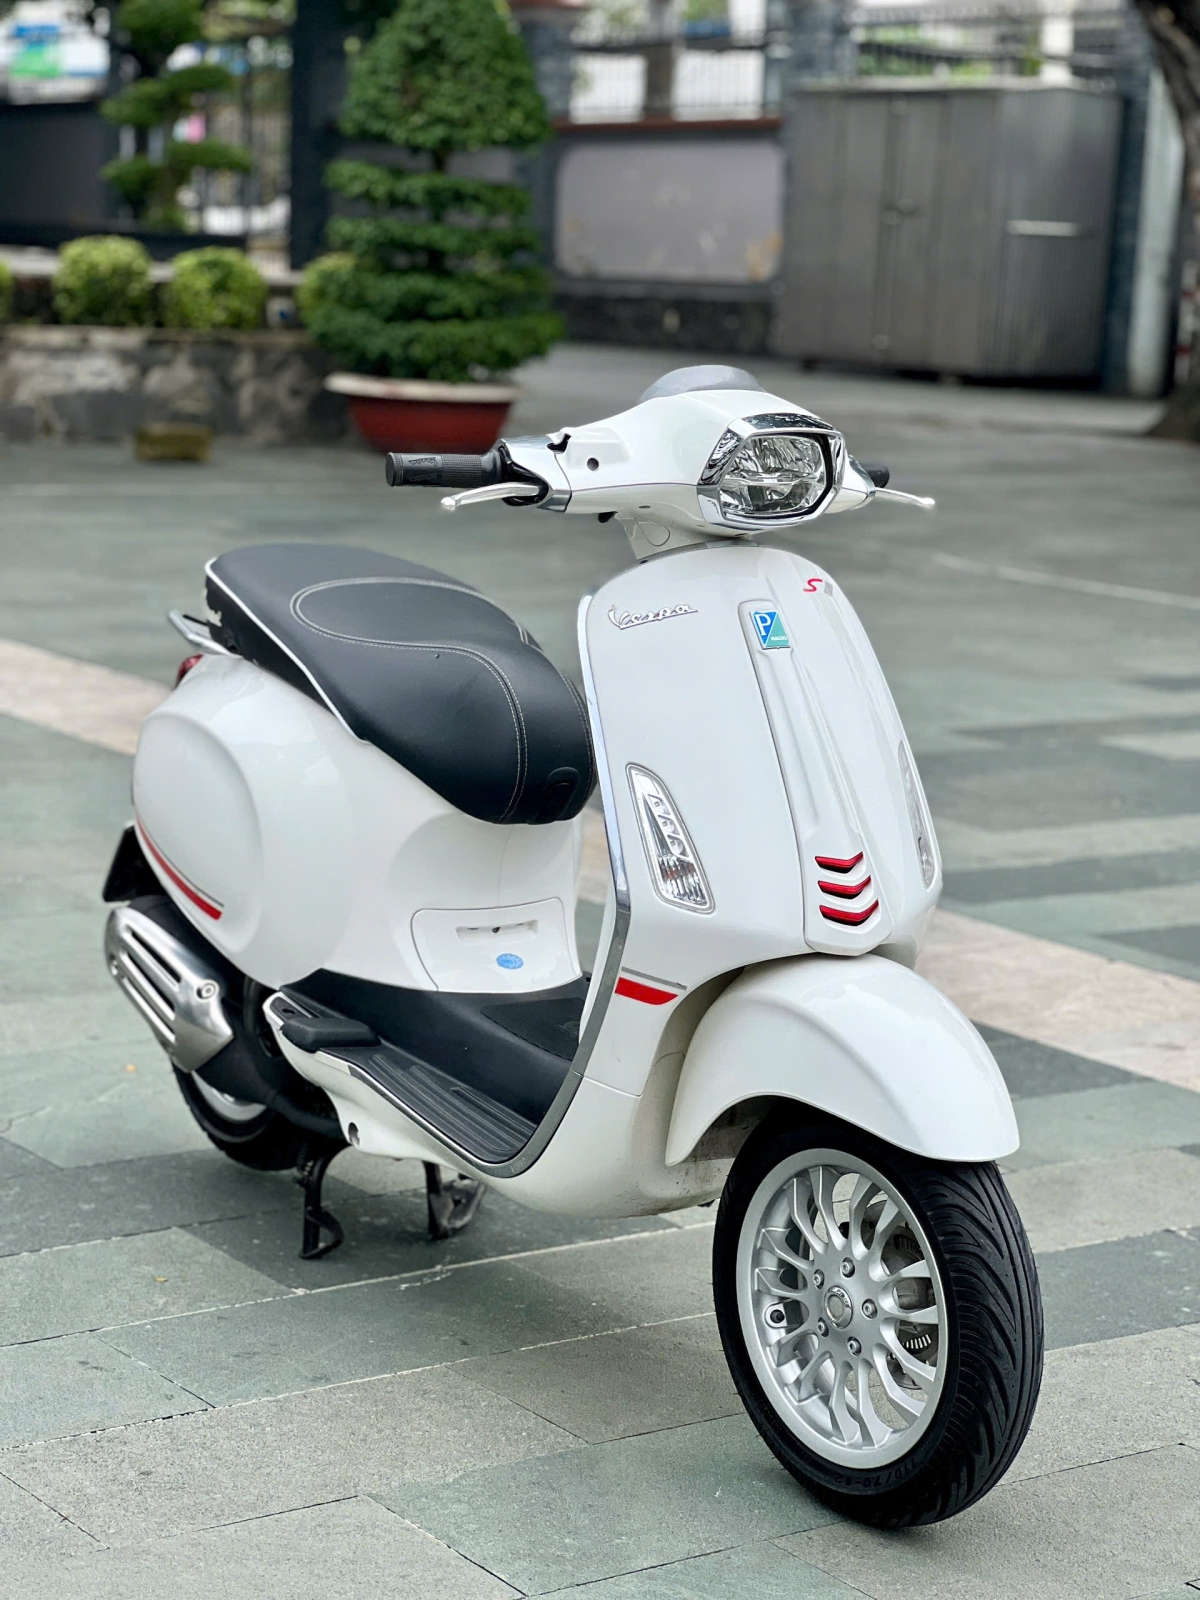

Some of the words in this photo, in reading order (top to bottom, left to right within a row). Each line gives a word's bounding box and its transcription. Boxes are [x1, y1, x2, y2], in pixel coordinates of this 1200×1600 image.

[803, 578, 823, 592] S
[608, 603, 698, 630] Vespa
[754, 613, 771, 636] P
